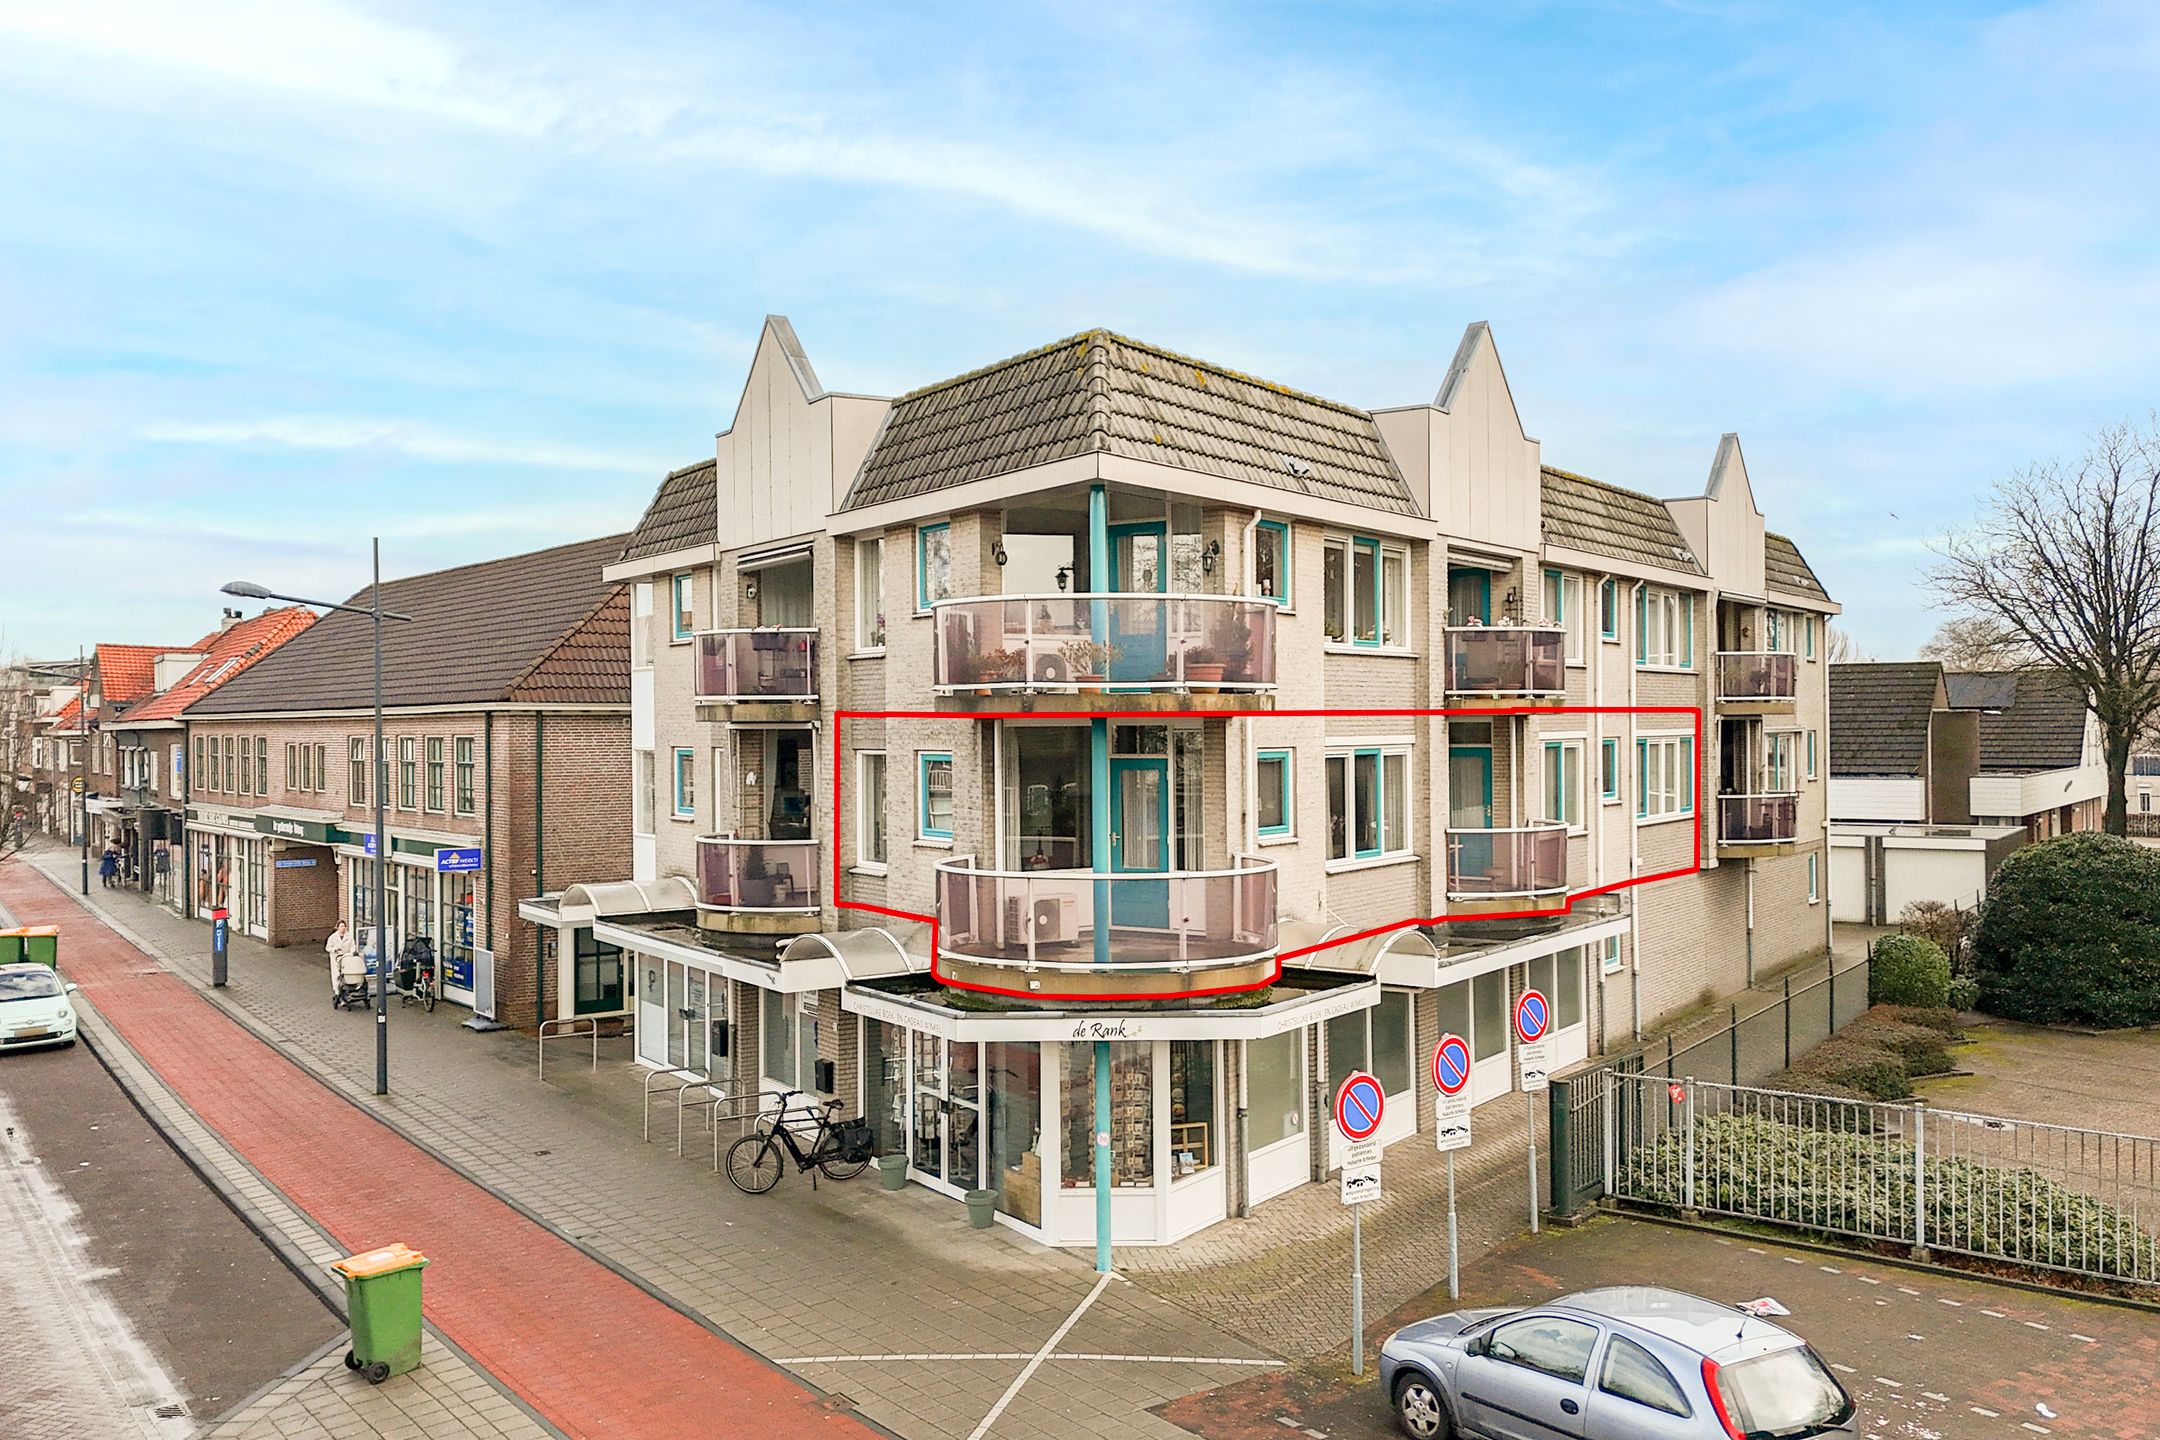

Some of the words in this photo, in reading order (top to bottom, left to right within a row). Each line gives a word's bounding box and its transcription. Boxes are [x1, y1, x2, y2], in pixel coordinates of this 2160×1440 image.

[216, 919, 224, 928] P
[1072, 1020, 1086, 1037] de
[1090, 1019, 1127, 1039] Rank
